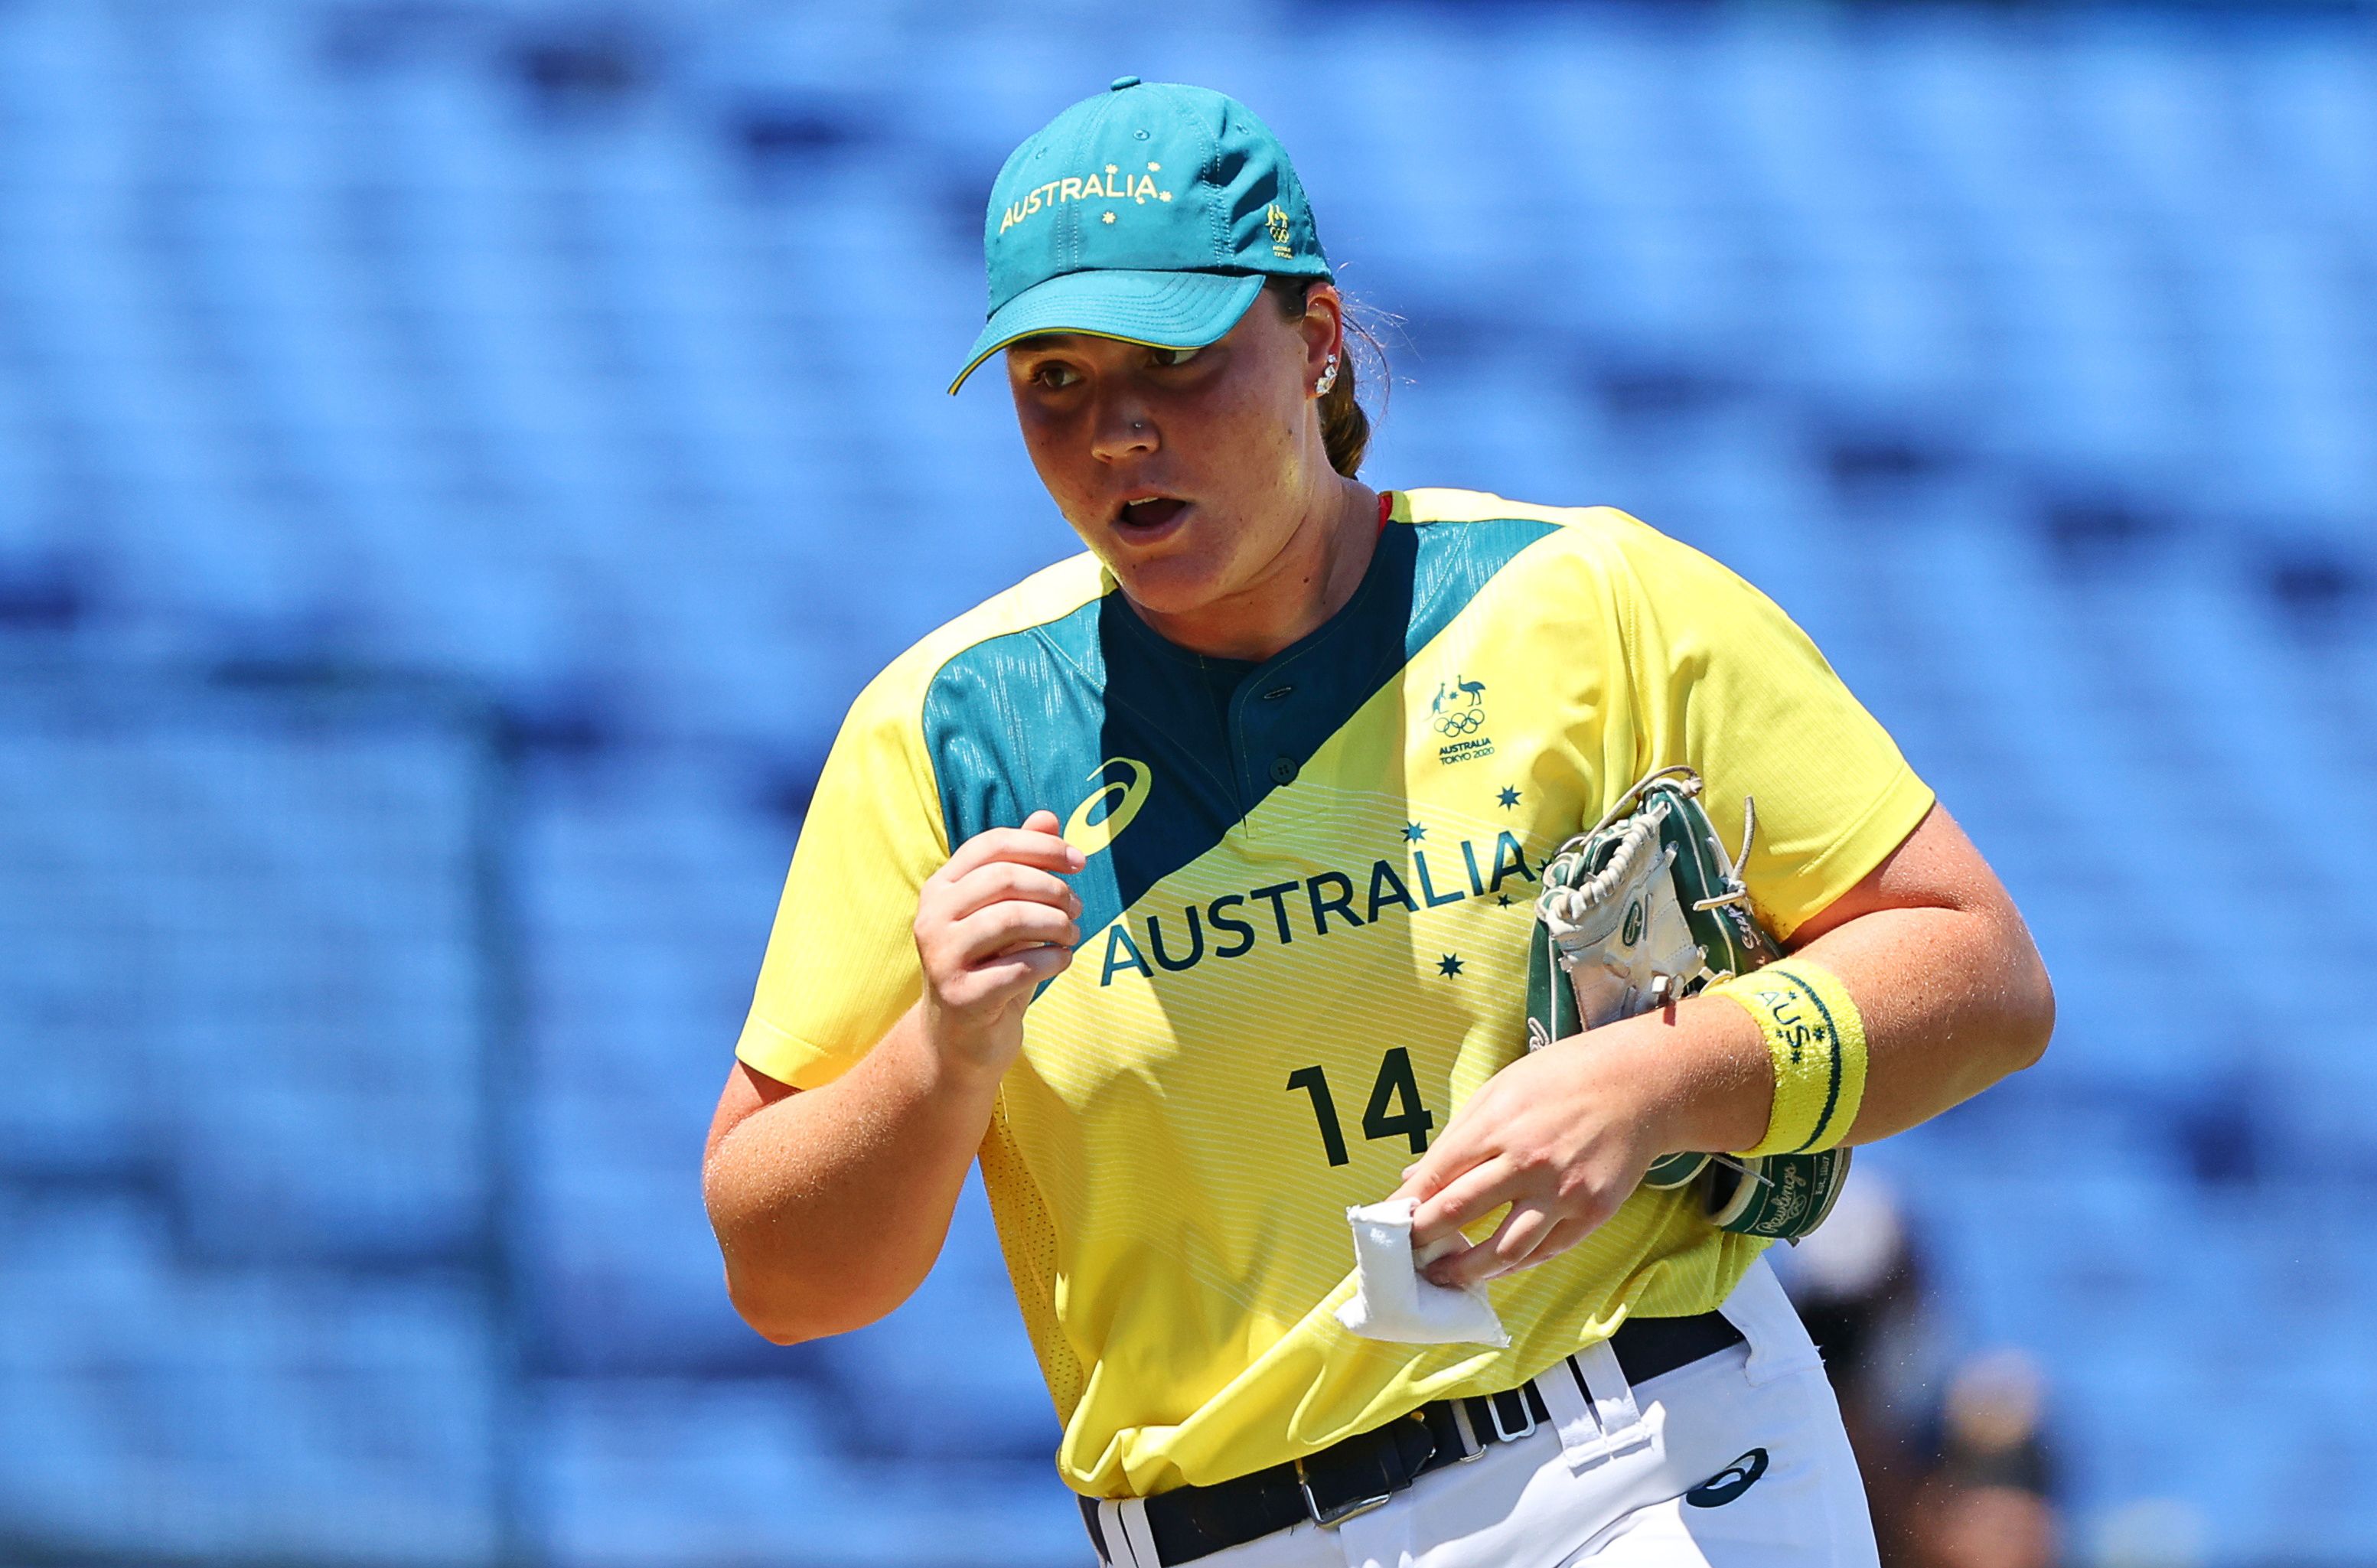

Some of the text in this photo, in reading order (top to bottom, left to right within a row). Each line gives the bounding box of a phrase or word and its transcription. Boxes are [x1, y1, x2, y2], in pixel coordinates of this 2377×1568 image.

[999, 174, 1158, 234] AUSTRALIA
[1440, 738, 1492, 755] AUSTRALIA
[1440, 747, 1495, 765] TOKYO 2020
[1100, 830, 1537, 987] AUSTRALIA
[1755, 992, 1810, 1048] AUS
[1286, 1046, 1433, 1167] 14
[1756, 1162, 1806, 1233] Rawlings
